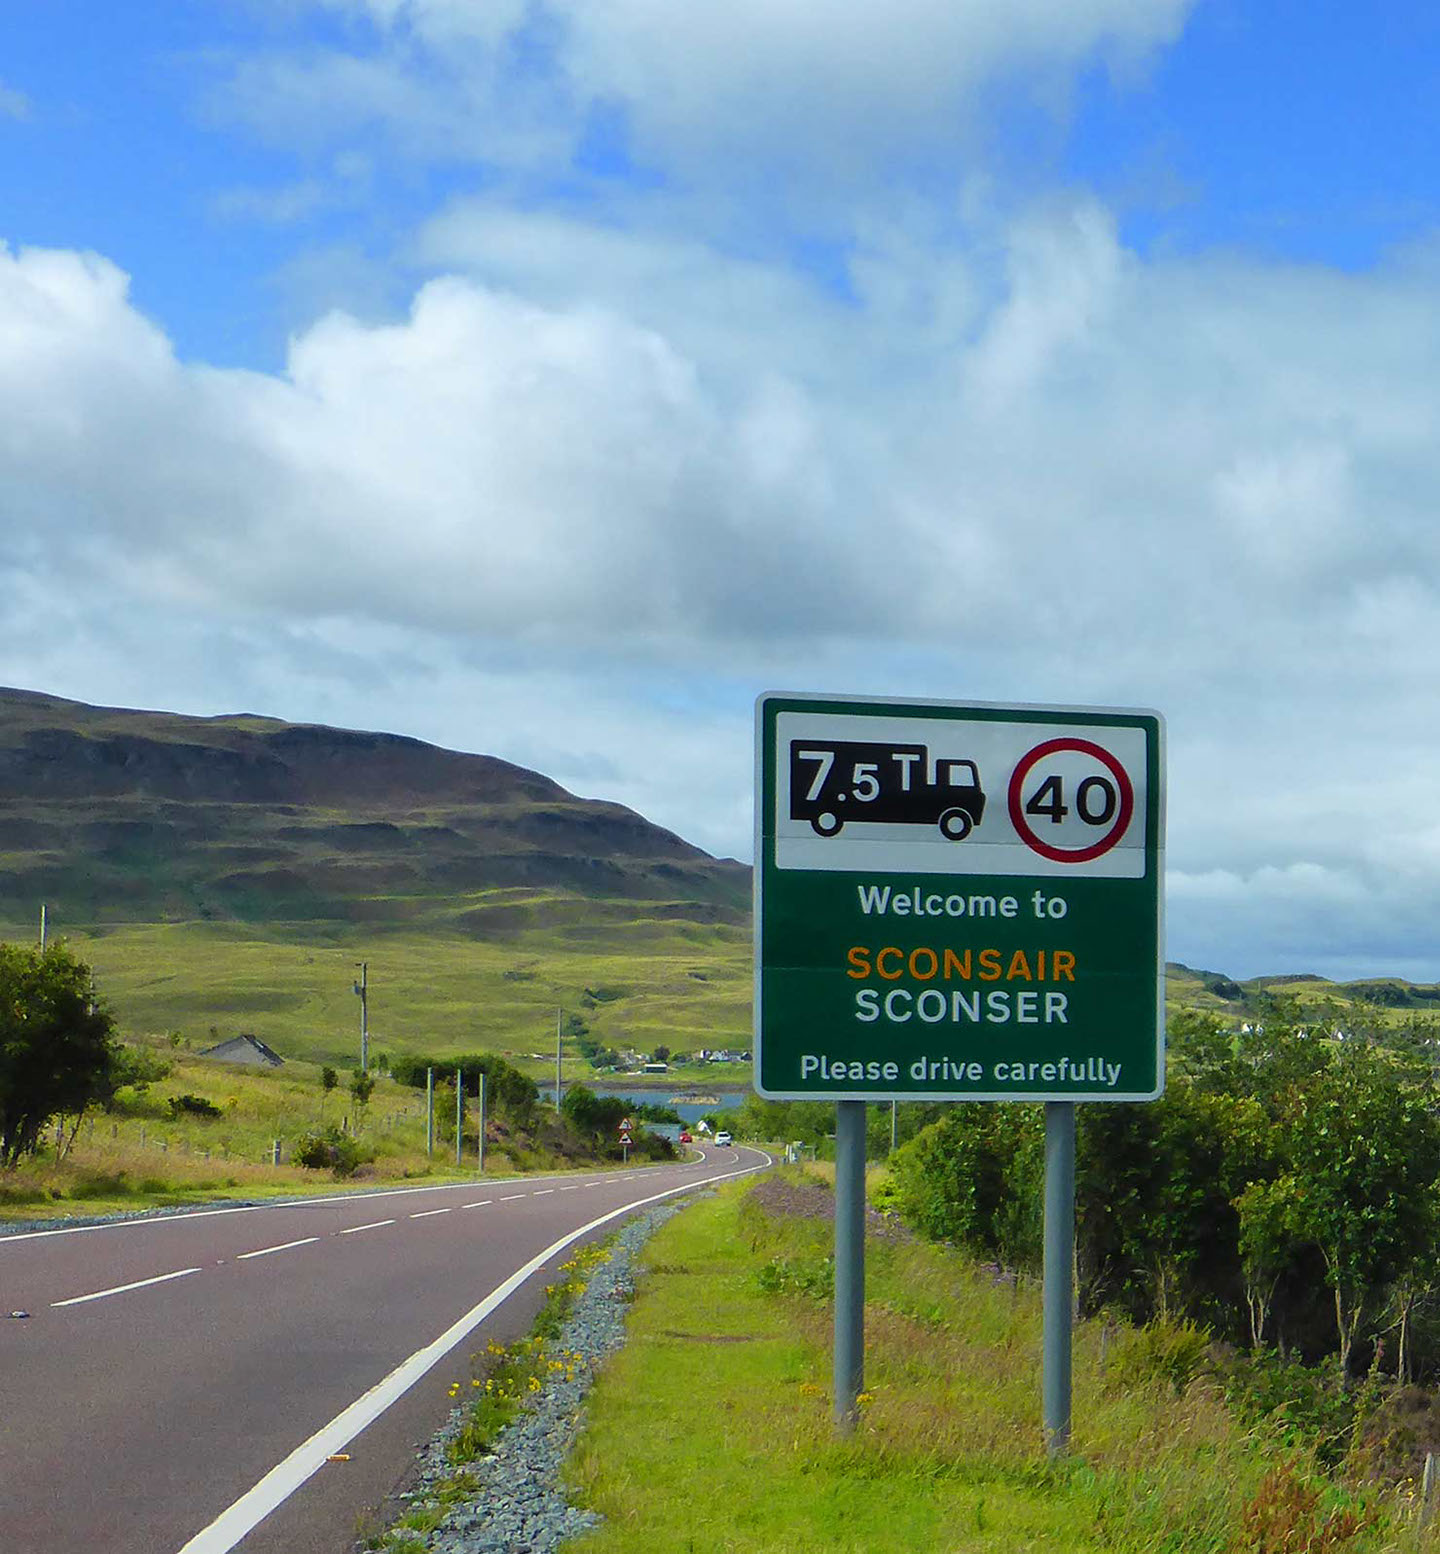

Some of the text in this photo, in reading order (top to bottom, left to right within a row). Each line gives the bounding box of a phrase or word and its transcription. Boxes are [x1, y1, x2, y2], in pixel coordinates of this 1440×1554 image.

[1026, 775, 1117, 826] 40
[858, 885, 1068, 919] Welcome to
[846, 946, 1077, 982] SCONSAIR
[854, 988, 1070, 1024] SCONSER
[800, 1055, 1122, 1087] Please drive carefully
